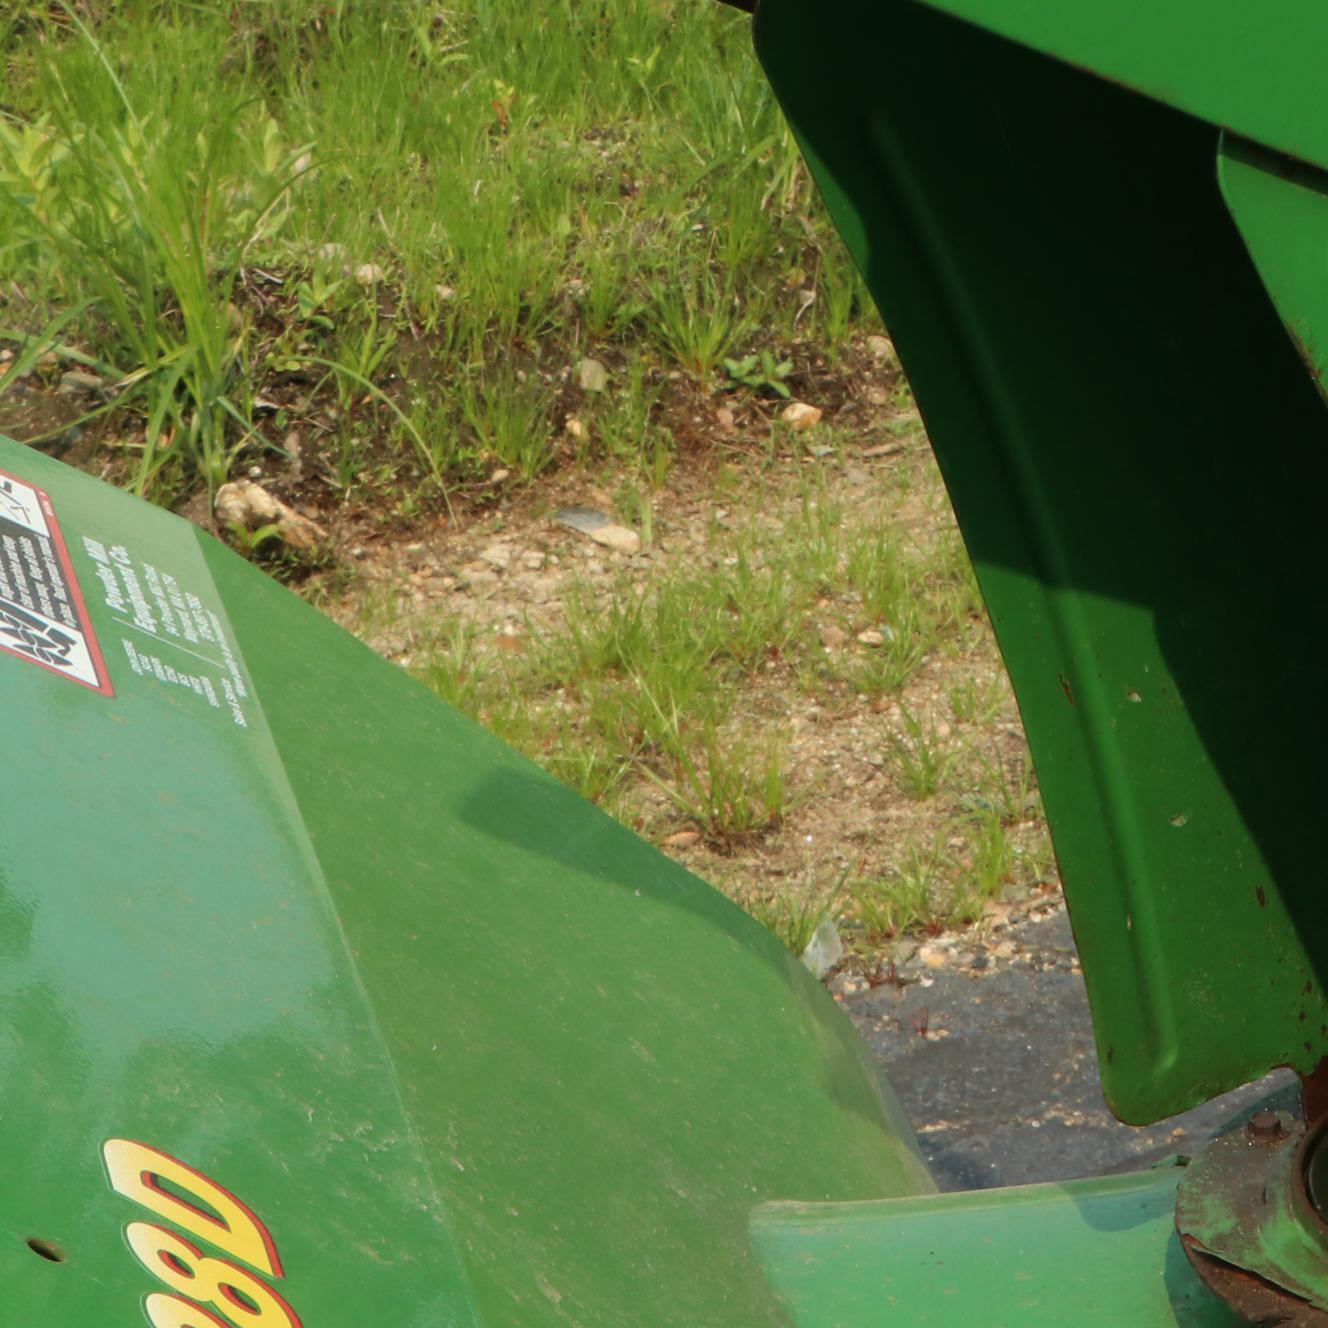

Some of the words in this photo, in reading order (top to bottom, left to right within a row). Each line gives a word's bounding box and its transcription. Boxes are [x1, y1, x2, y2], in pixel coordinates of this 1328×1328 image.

[82, 536, 110, 565] Mill
[95, 561, 128, 613] Powder
[113, 562, 157, 633] Equipment
[102, 1137, 305, 1328] 8D
